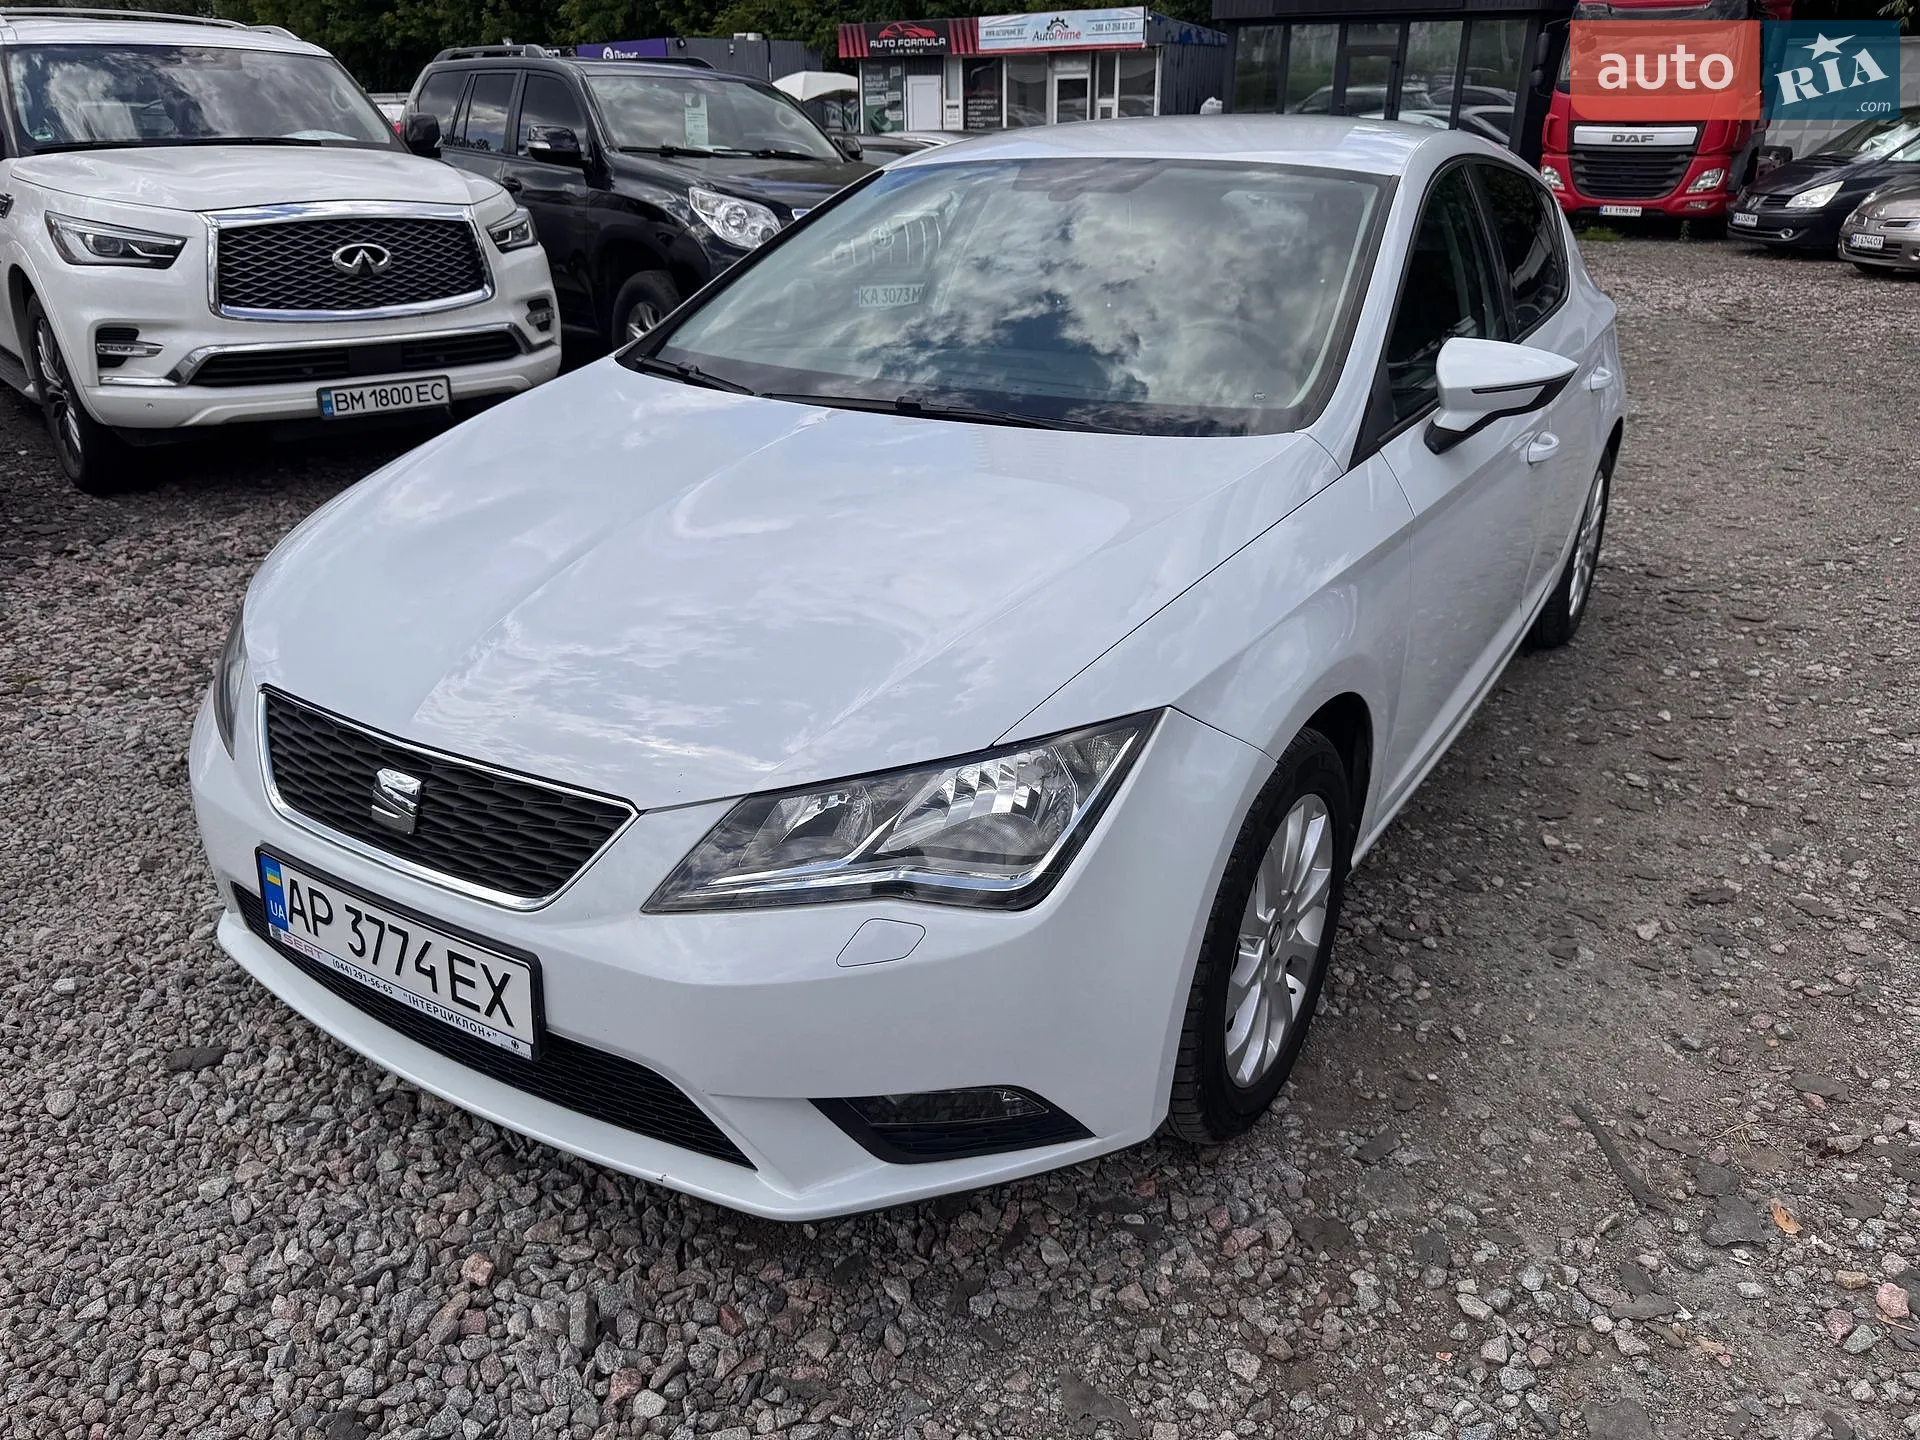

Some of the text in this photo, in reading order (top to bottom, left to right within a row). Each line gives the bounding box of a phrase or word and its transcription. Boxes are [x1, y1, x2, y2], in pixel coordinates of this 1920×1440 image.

[870, 37, 947, 49] AUTO FORMULA
[1032, 29, 1082, 42] AutoPrime
[1611, 134, 1656, 144] DAF
[334, 383, 444, 412] BM 1800 EC
[270, 899, 287, 922] UA
[283, 933, 324, 961] SEAT
[288, 878, 515, 1029] AP 3774 EX
